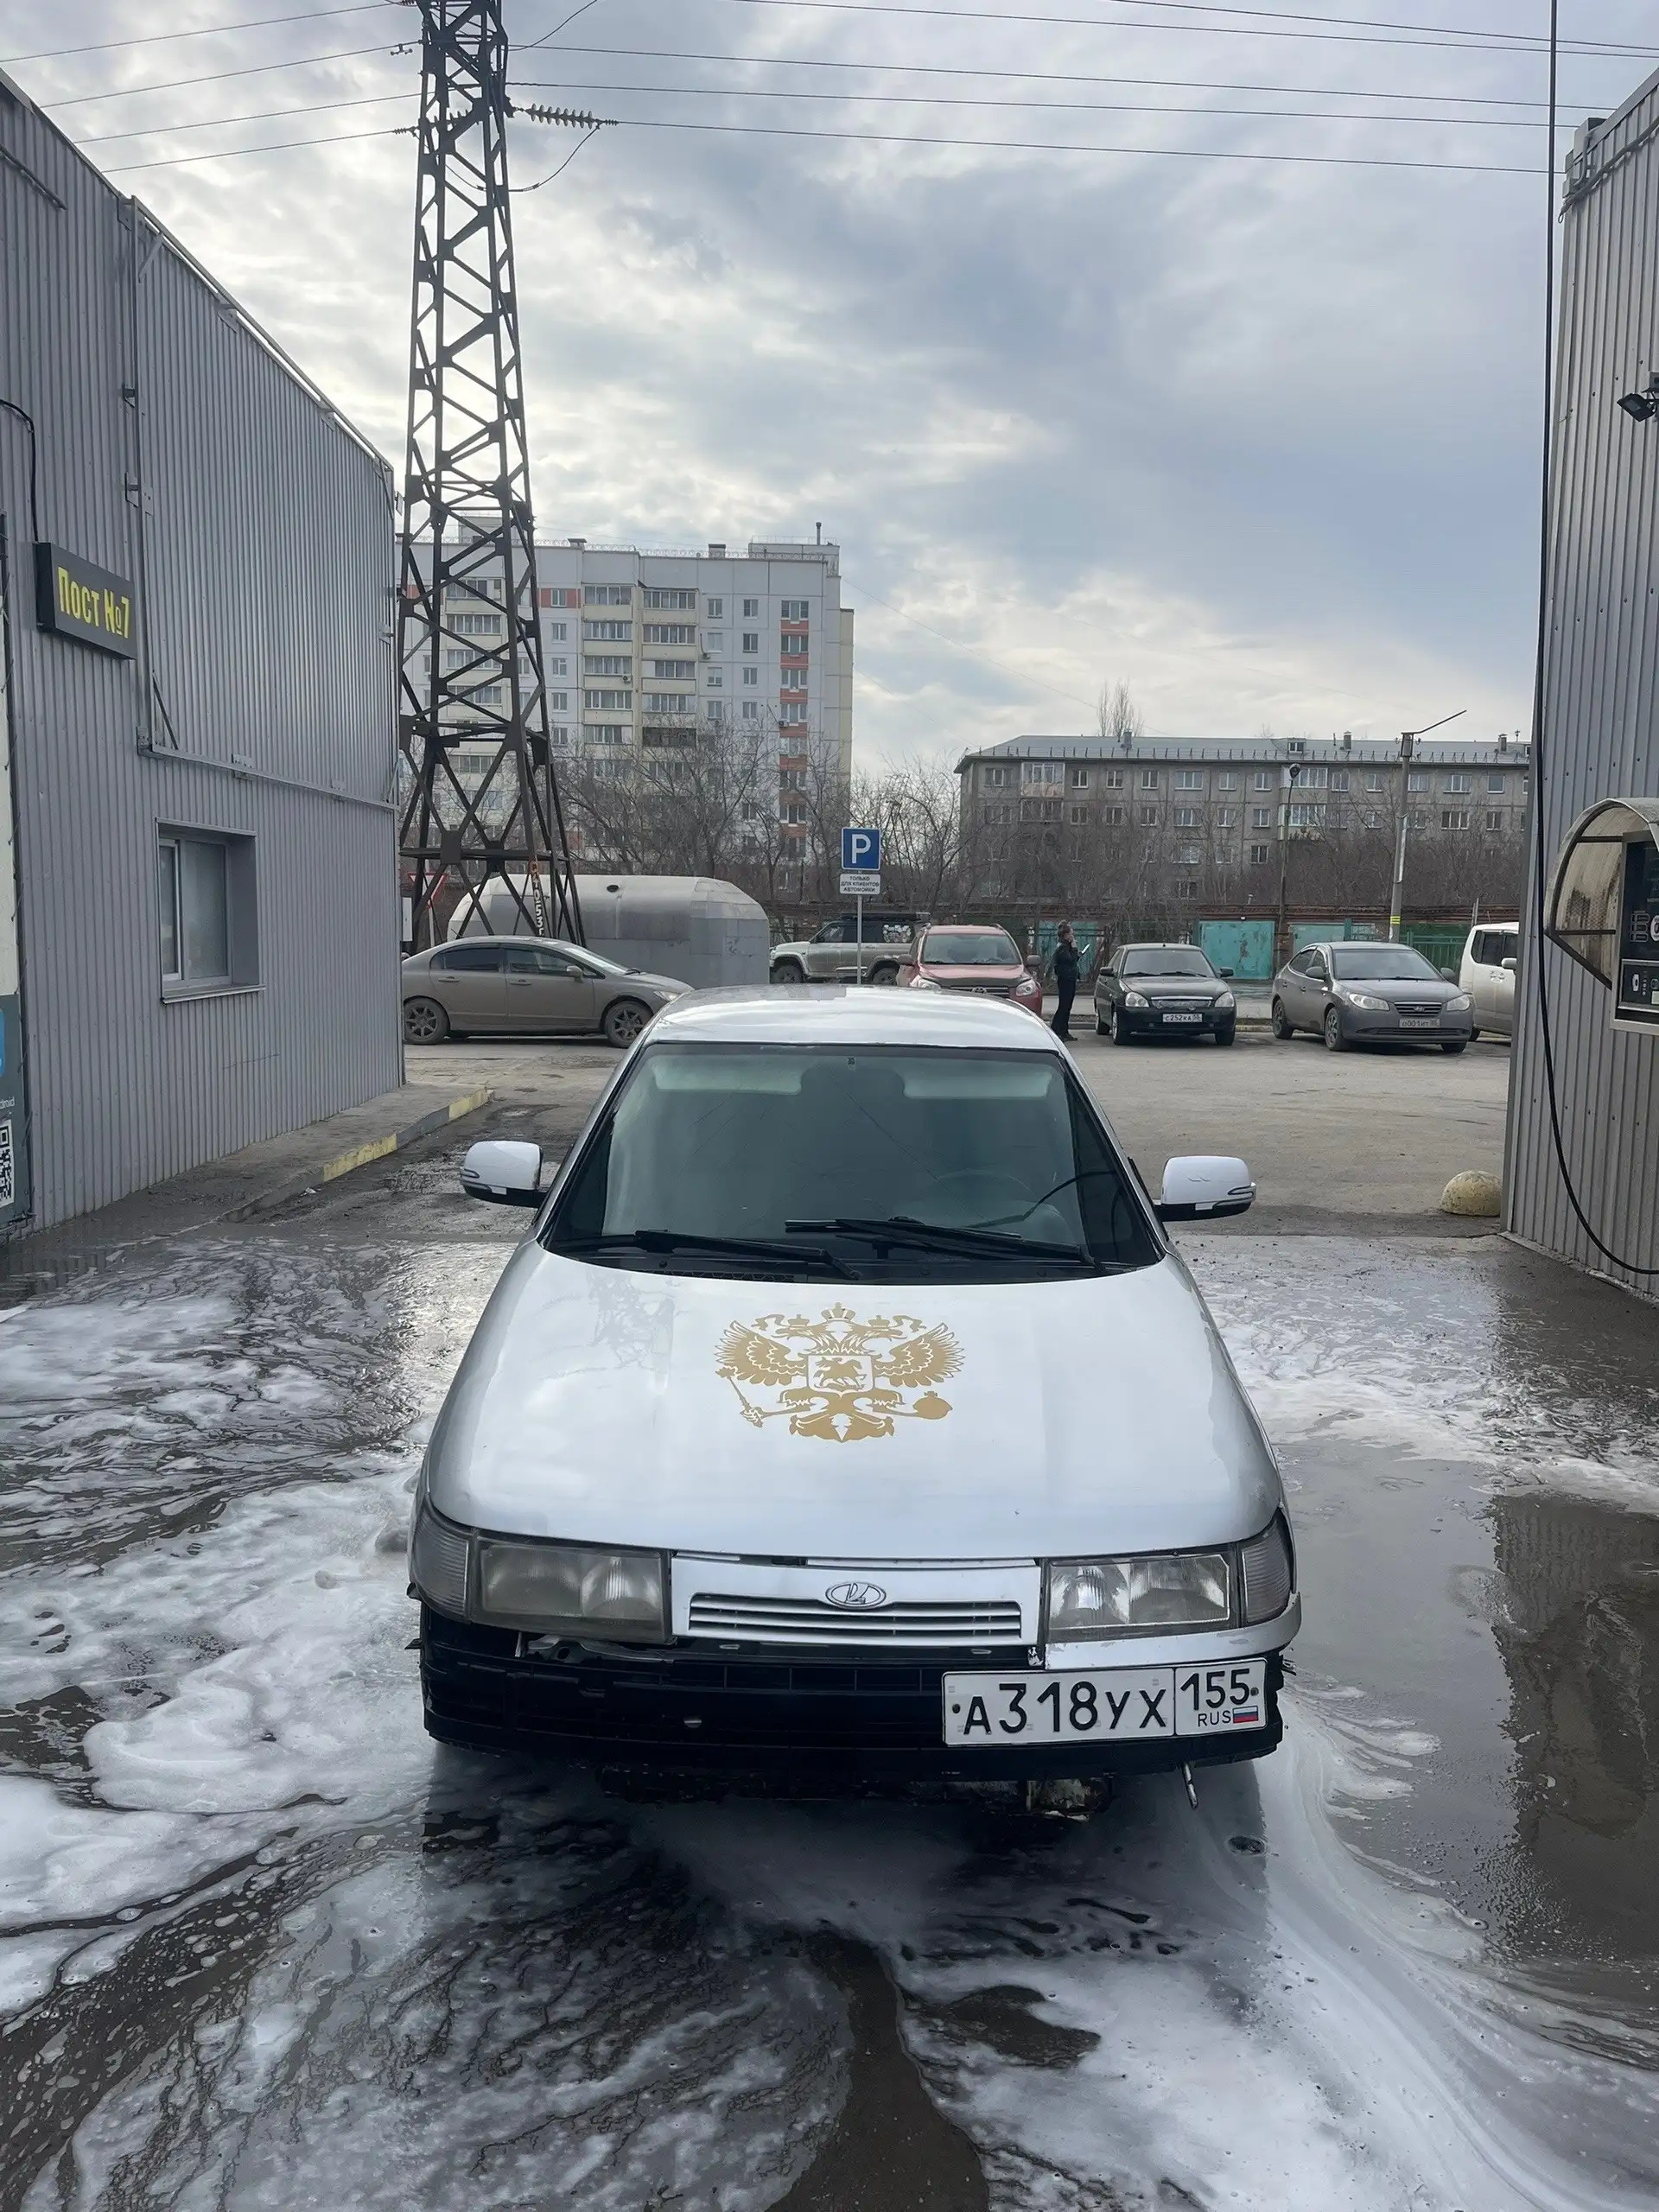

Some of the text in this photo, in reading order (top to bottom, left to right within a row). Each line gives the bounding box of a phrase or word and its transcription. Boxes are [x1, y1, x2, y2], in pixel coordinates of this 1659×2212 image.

[58, 566, 130, 639] Пост №7
[851, 834, 871, 864] P
[963, 1669, 1250, 1735] А318УХ 155
[1198, 1710, 1231, 1726] RUS
